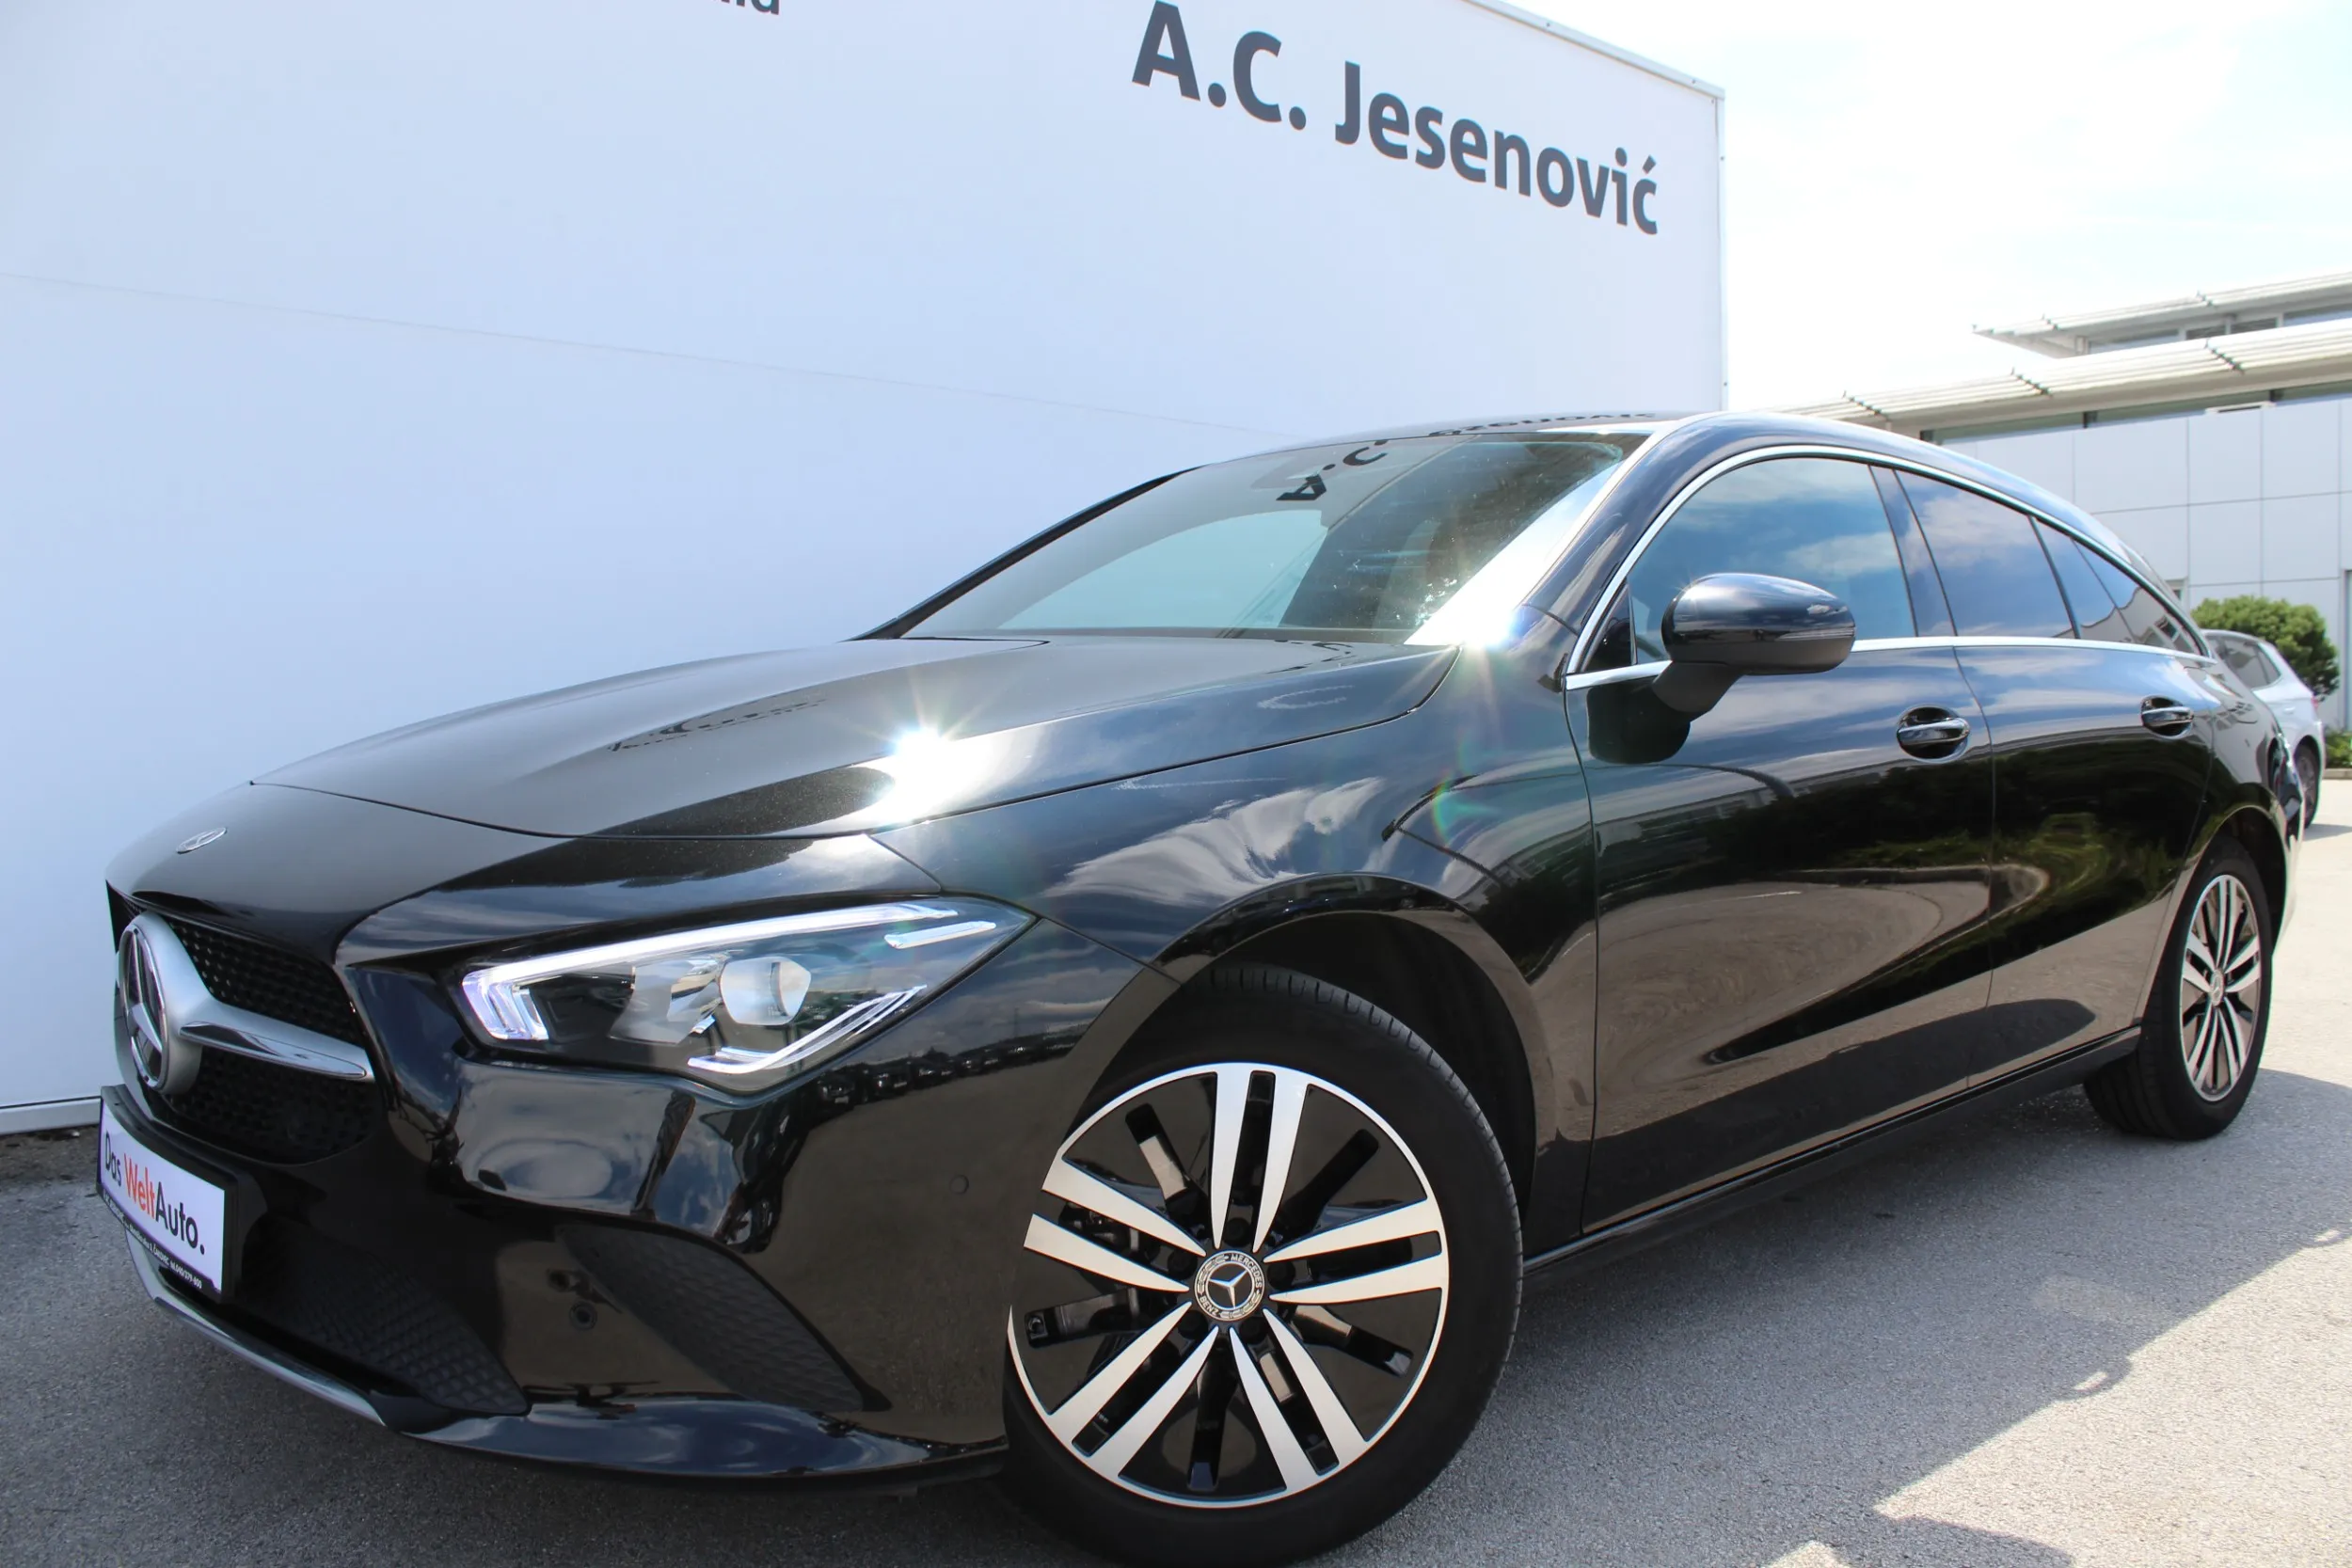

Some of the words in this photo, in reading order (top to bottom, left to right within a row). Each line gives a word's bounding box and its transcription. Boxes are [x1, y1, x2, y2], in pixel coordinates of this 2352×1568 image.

[1132, 0, 1307, 131] A.C.
[1334, 60, 1658, 235] Jesenović
[105, 1132, 122, 1187] Das
[1231, 1253, 1263, 1288] MERCEDES
[1200, 1295, 1219, 1316] BENZ
